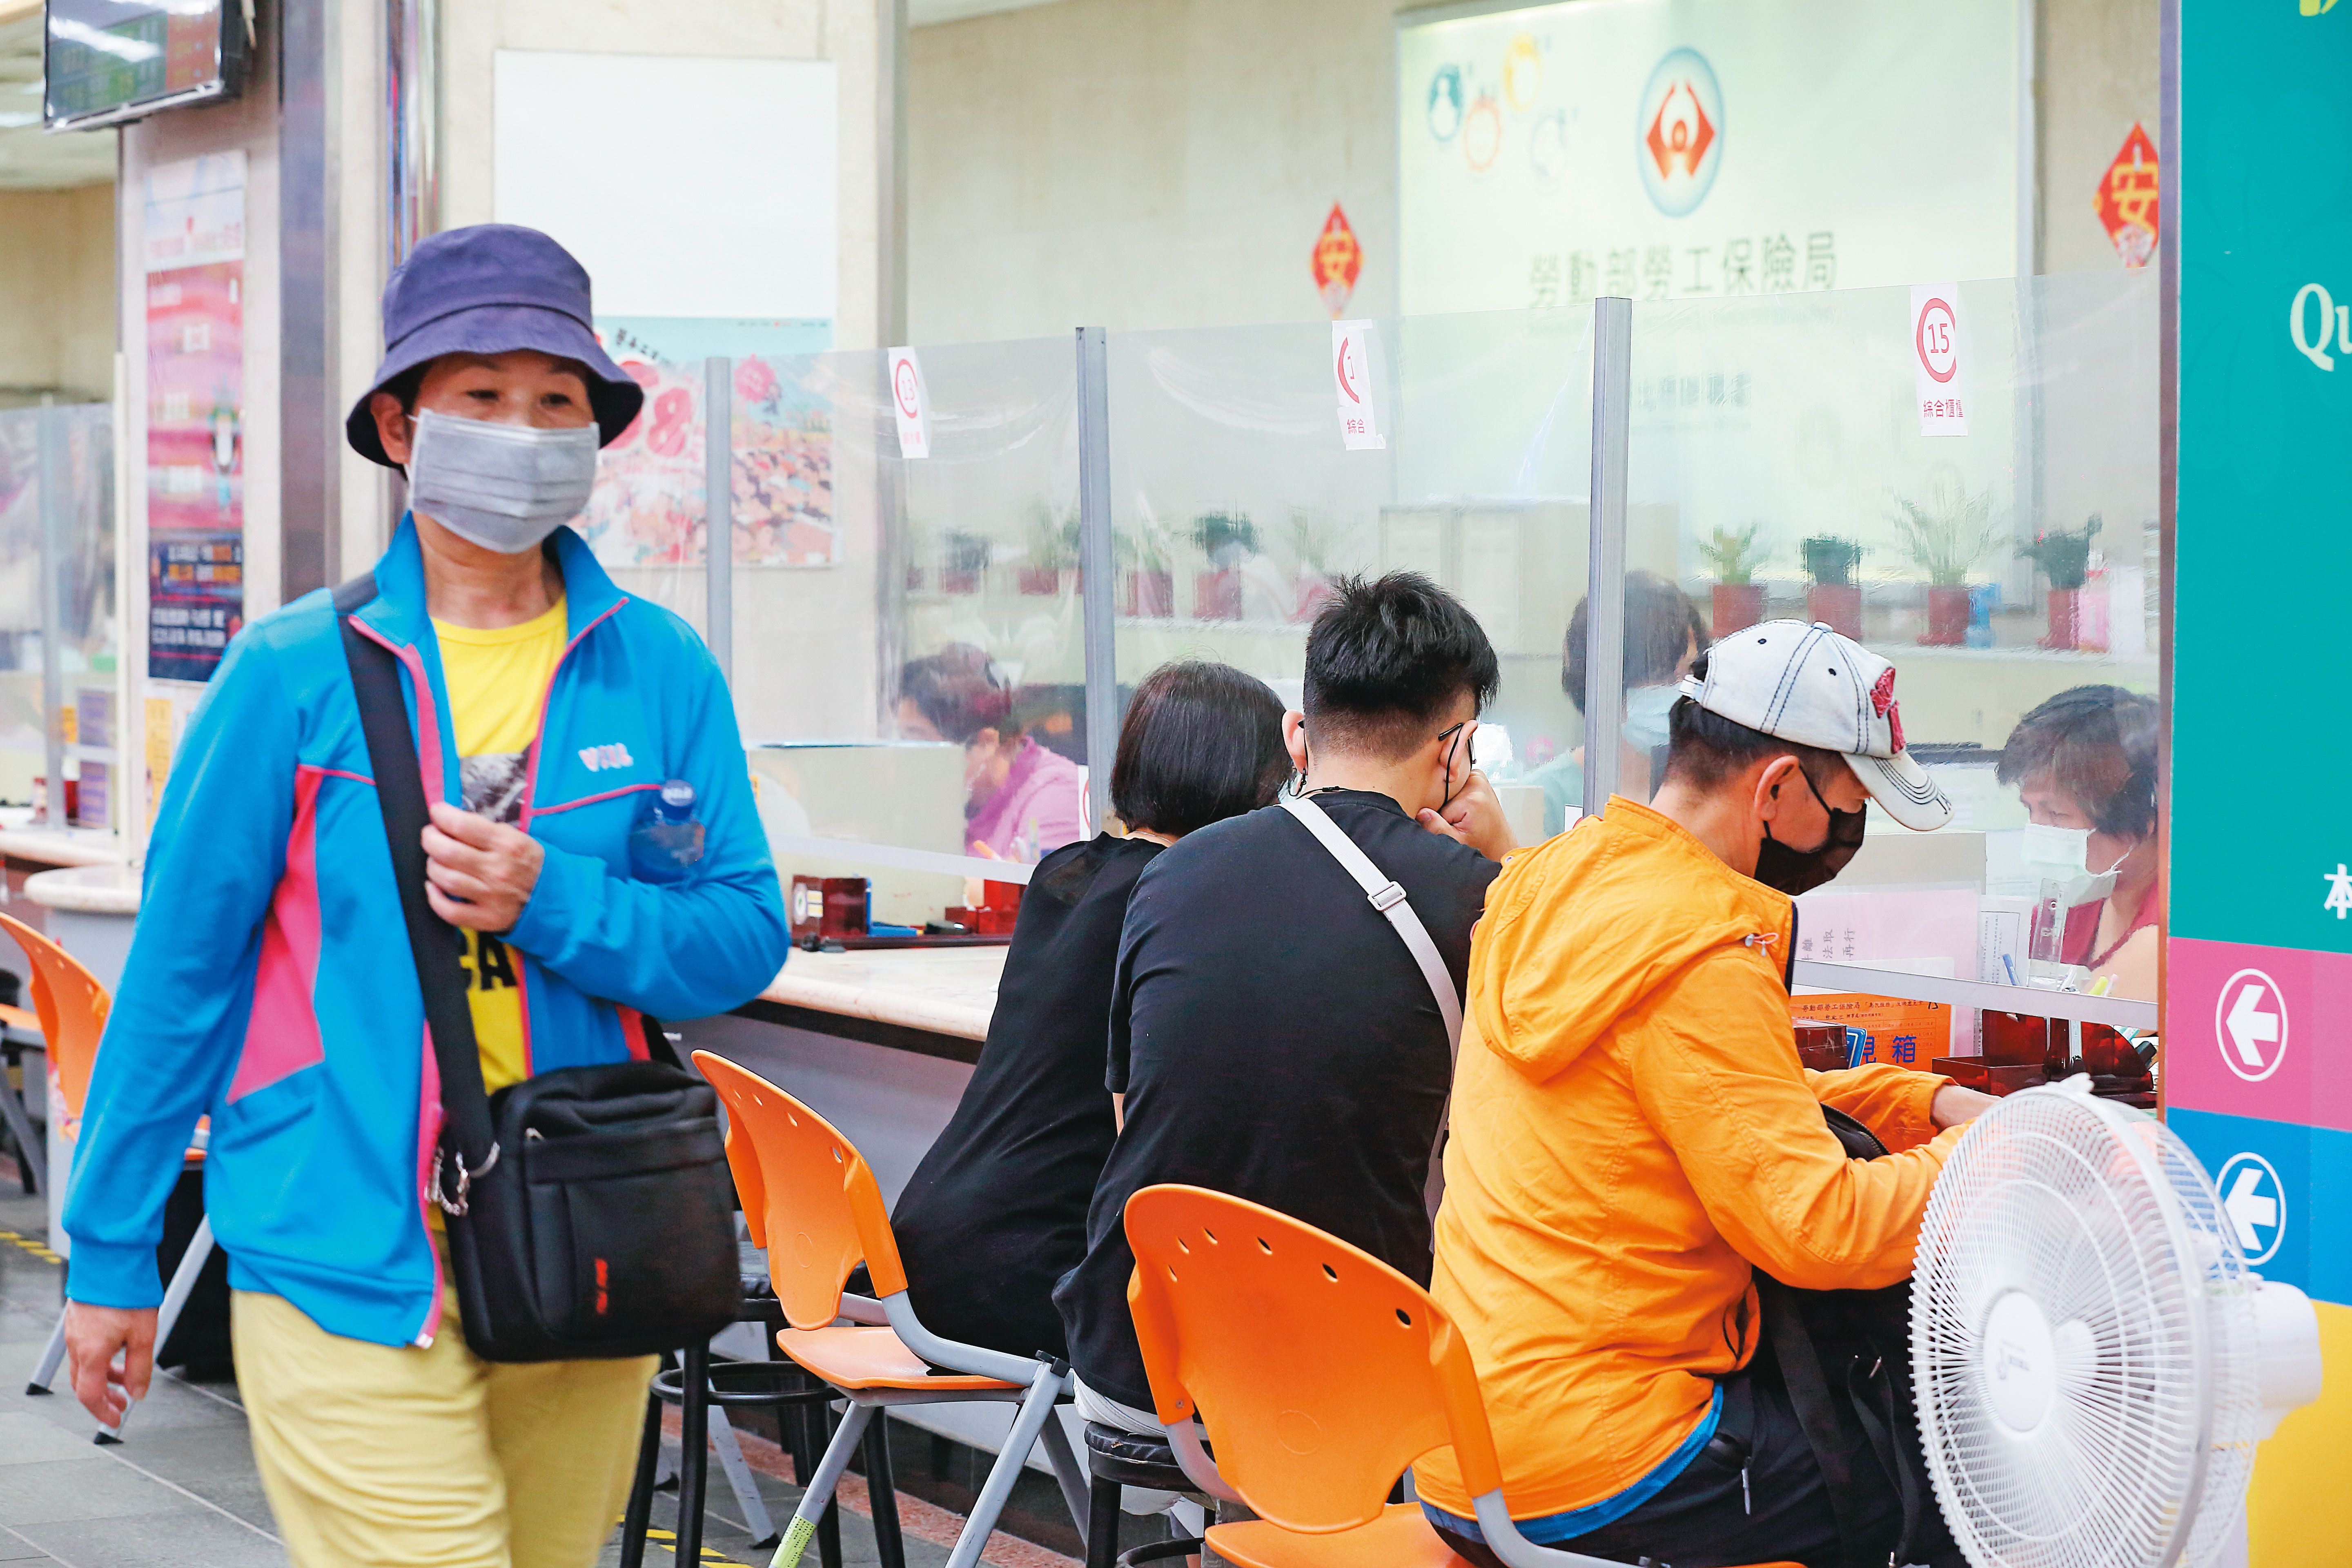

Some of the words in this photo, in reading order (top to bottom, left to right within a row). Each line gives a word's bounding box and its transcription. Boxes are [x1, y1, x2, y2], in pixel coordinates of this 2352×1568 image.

[1530, 231, 1838, 309] 勞動部勞工保險局
[1928, 323, 1949, 353] 15
[1347, 419, 1365, 434] 綜合
[2324, 863, 2352, 920] 本
